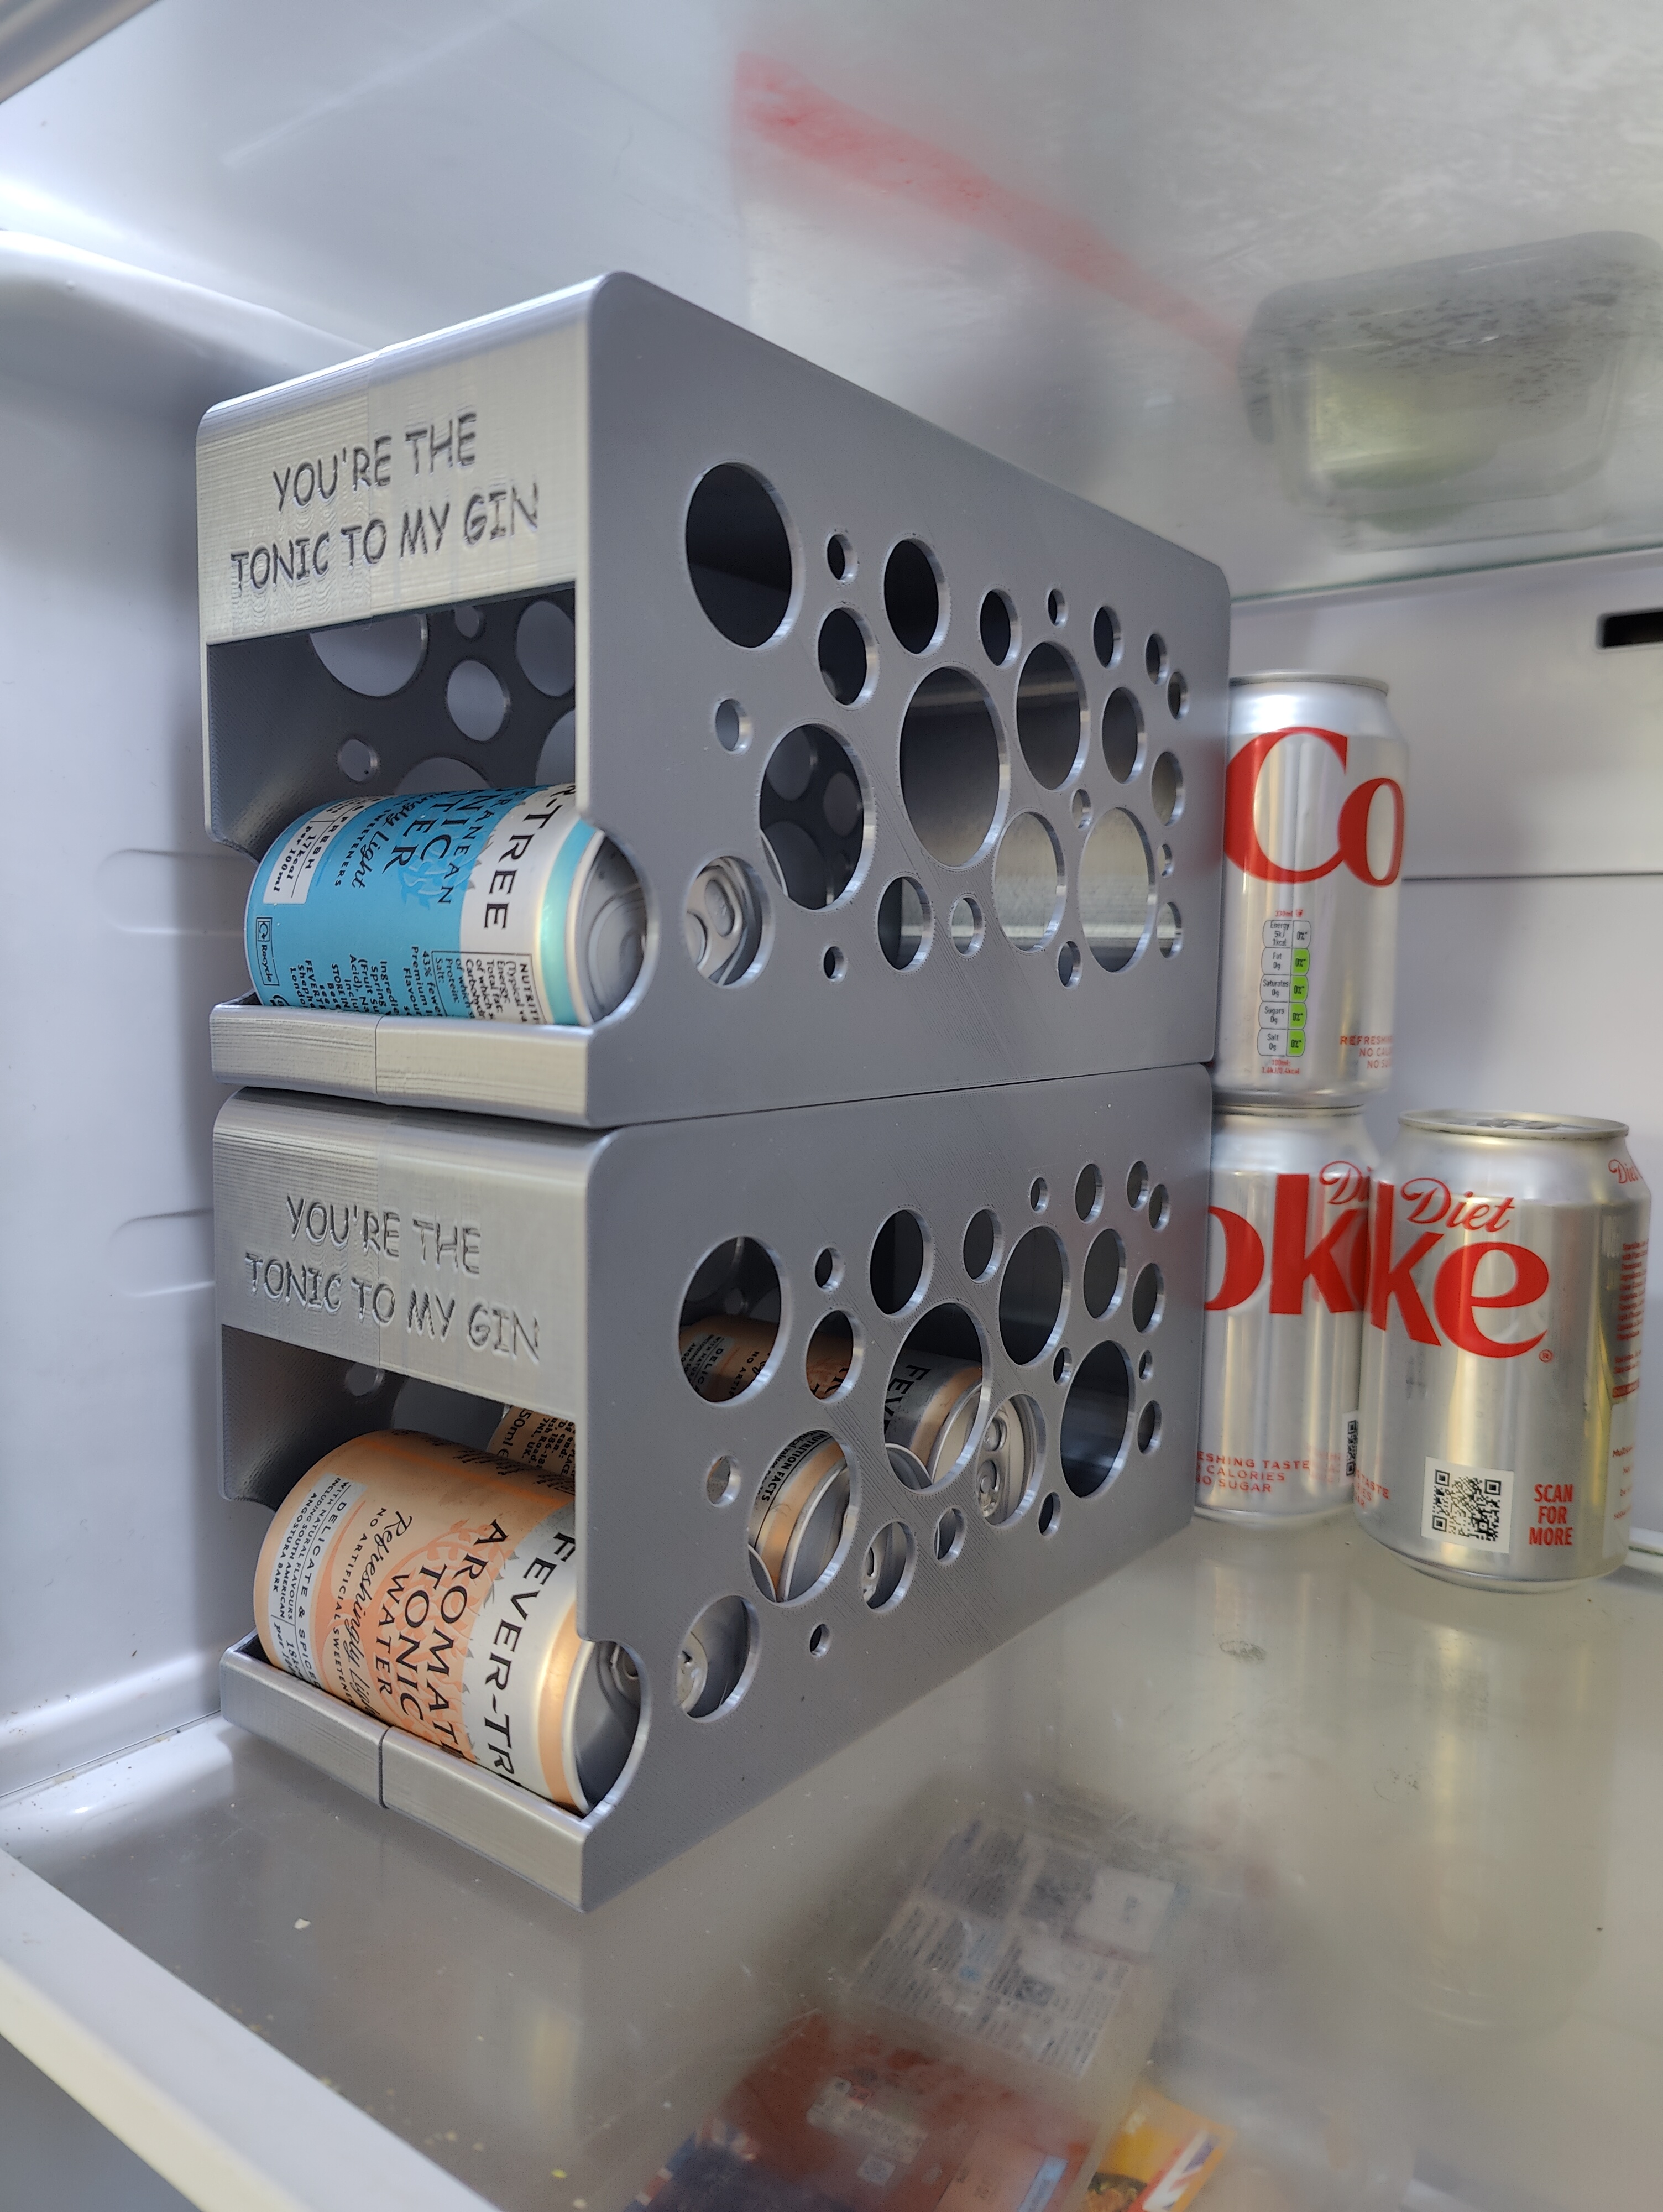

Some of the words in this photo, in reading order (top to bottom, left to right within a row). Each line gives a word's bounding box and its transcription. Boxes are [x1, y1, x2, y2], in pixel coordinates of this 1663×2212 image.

[273, 435, 392, 511] YOU'RE
[405, 412, 477, 476] THE
[231, 532, 330, 592] TONIC
[341, 518, 387, 568] TO
[400, 502, 450, 559] MY
[464, 482, 538, 546] GIN
[296, 826, 313, 845] per
[273, 848, 296, 892] 100ml
[286, 834, 317, 880] 17kcal
[352, 831, 389, 889] Light
[1270, 920, 1290, 930] Energy
[332, 963, 345, 995] STORE
[358, 959, 373, 995] (Fruit
[411, 946, 428, 1005] Premium
[422, 951, 433, 977] 43%
[290, 967, 307, 1008] Londo
[370, 966, 387, 1007] Spring
[380, 961, 400, 1014] Ingredie
[520, 963, 540, 1023] NUTRITI
[1264, 1006, 1284, 1016] Sugars
[1267, 1033, 1279, 1041] Salt
[1400, 1177, 1515, 1232] Diet
[286, 1194, 400, 1258] YOU'RE
[412, 1219, 480, 1275] THE
[245, 1252, 341, 1314] TONIC
[351, 1276, 395, 1326] TO
[406, 1288, 456, 1342] MY
[467, 1303, 540, 1364] GIN
[781, 1433, 827, 1470] NUTRITION
[1263, 1460, 1310, 1469] TASTE
[327, 1481, 349, 1505] WITH
[761, 1471, 785, 1501] FACTS
[1206, 1465, 1285, 1481] CALORIES
[1219, 1478, 1272, 1493] SUGAR
[1534, 1484, 1573, 1503] SCAN
[306, 1477, 341, 1522] INCLUDING
[370, 1507, 387, 1527] NO
[1538, 1505, 1567, 1525] FOR
[280, 1493, 317, 1558] ANGOSTURA
[289, 1524, 307, 1559] SOUTH
[298, 1509, 327, 1558] NATURAL
[1529, 1526, 1573, 1546] MORE
[301, 1501, 347, 1597] DELICATE
[273, 1562, 283, 1592] BARK
[280, 1562, 292, 1619] AMERICAN
[287, 1562, 301, 1620] FLAVOURS
[334, 1533, 368, 1620] ARTIFICIAL
[343, 1511, 412, 1668] Refreshingly
[299, 1606, 305, 1618] &
[376, 1573, 411, 1695] WATER
[396, 1563, 448, 1721] TONIC
[484, 1532, 576, 1775] FEVER-TR
